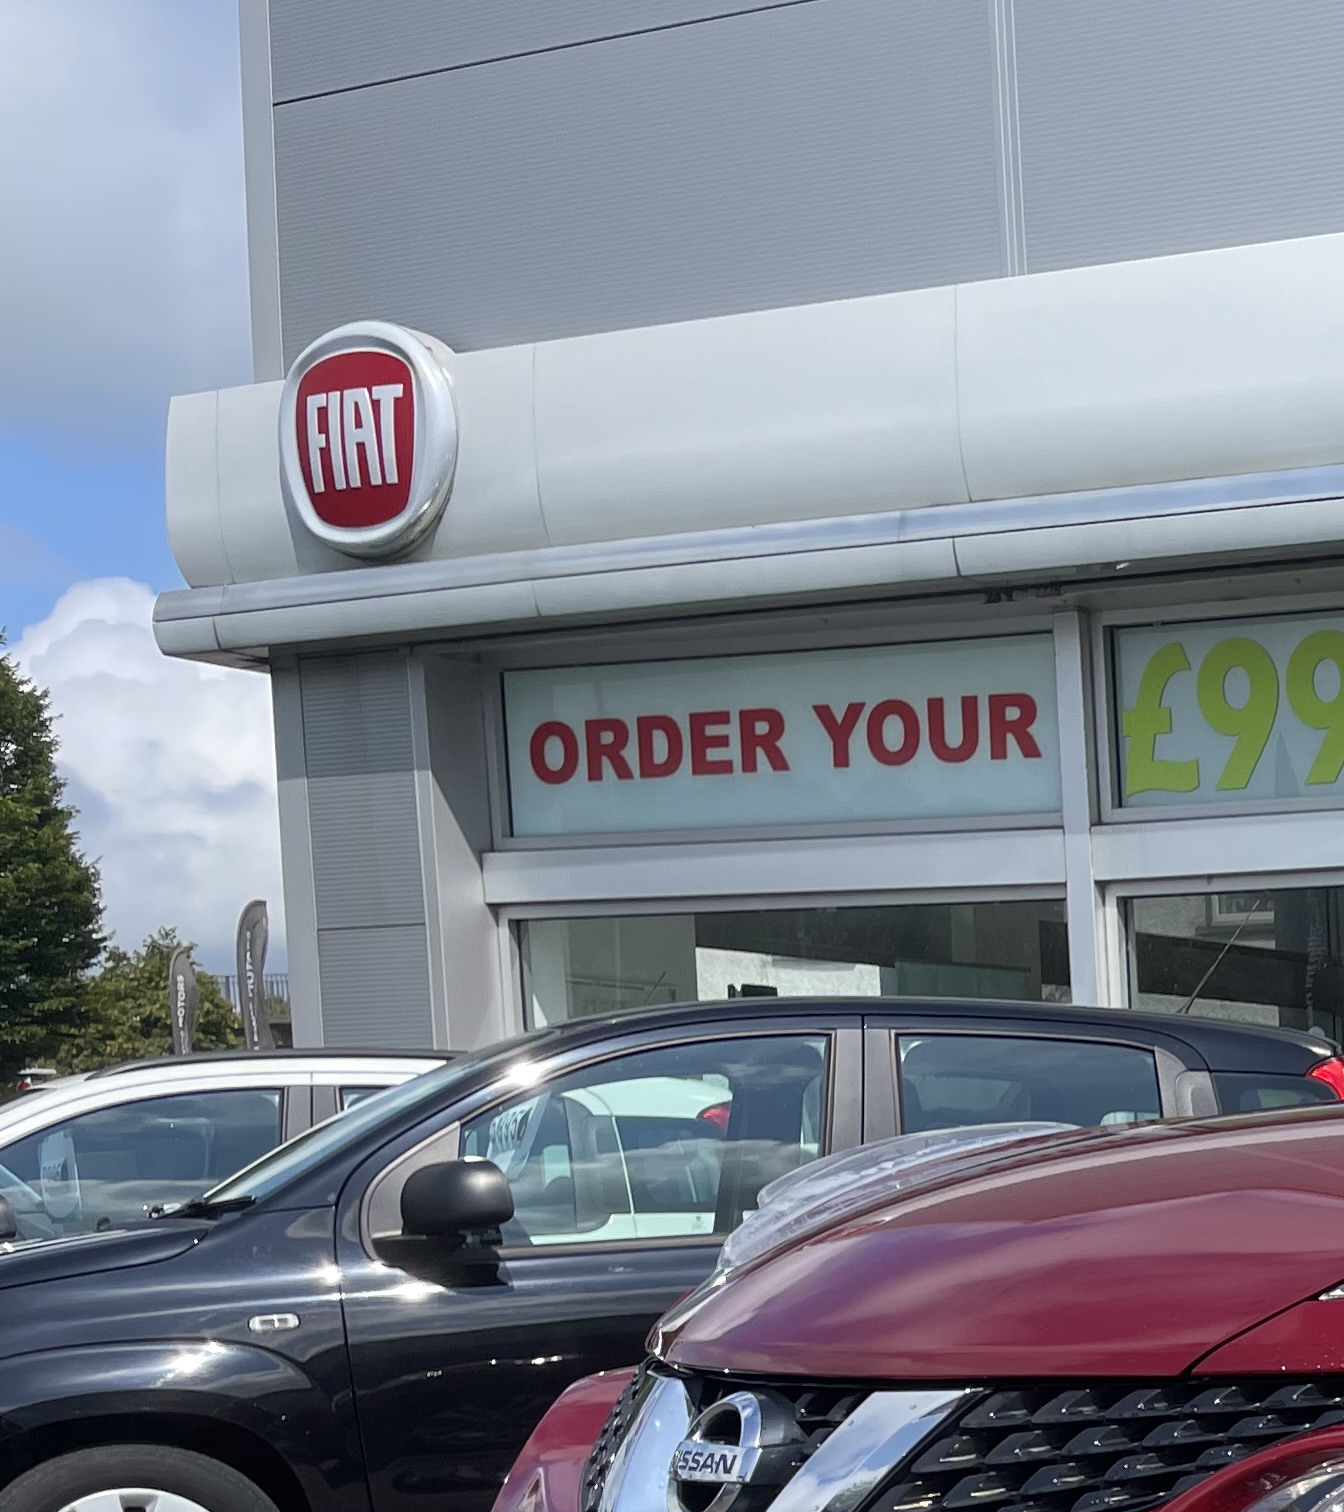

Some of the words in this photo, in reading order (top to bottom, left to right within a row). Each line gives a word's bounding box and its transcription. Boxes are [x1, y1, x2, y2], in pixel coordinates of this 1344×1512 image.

[306, 384, 403, 494] FIAT
[529, 708, 790, 784] ORDER
[812, 692, 1042, 769] YOUR
